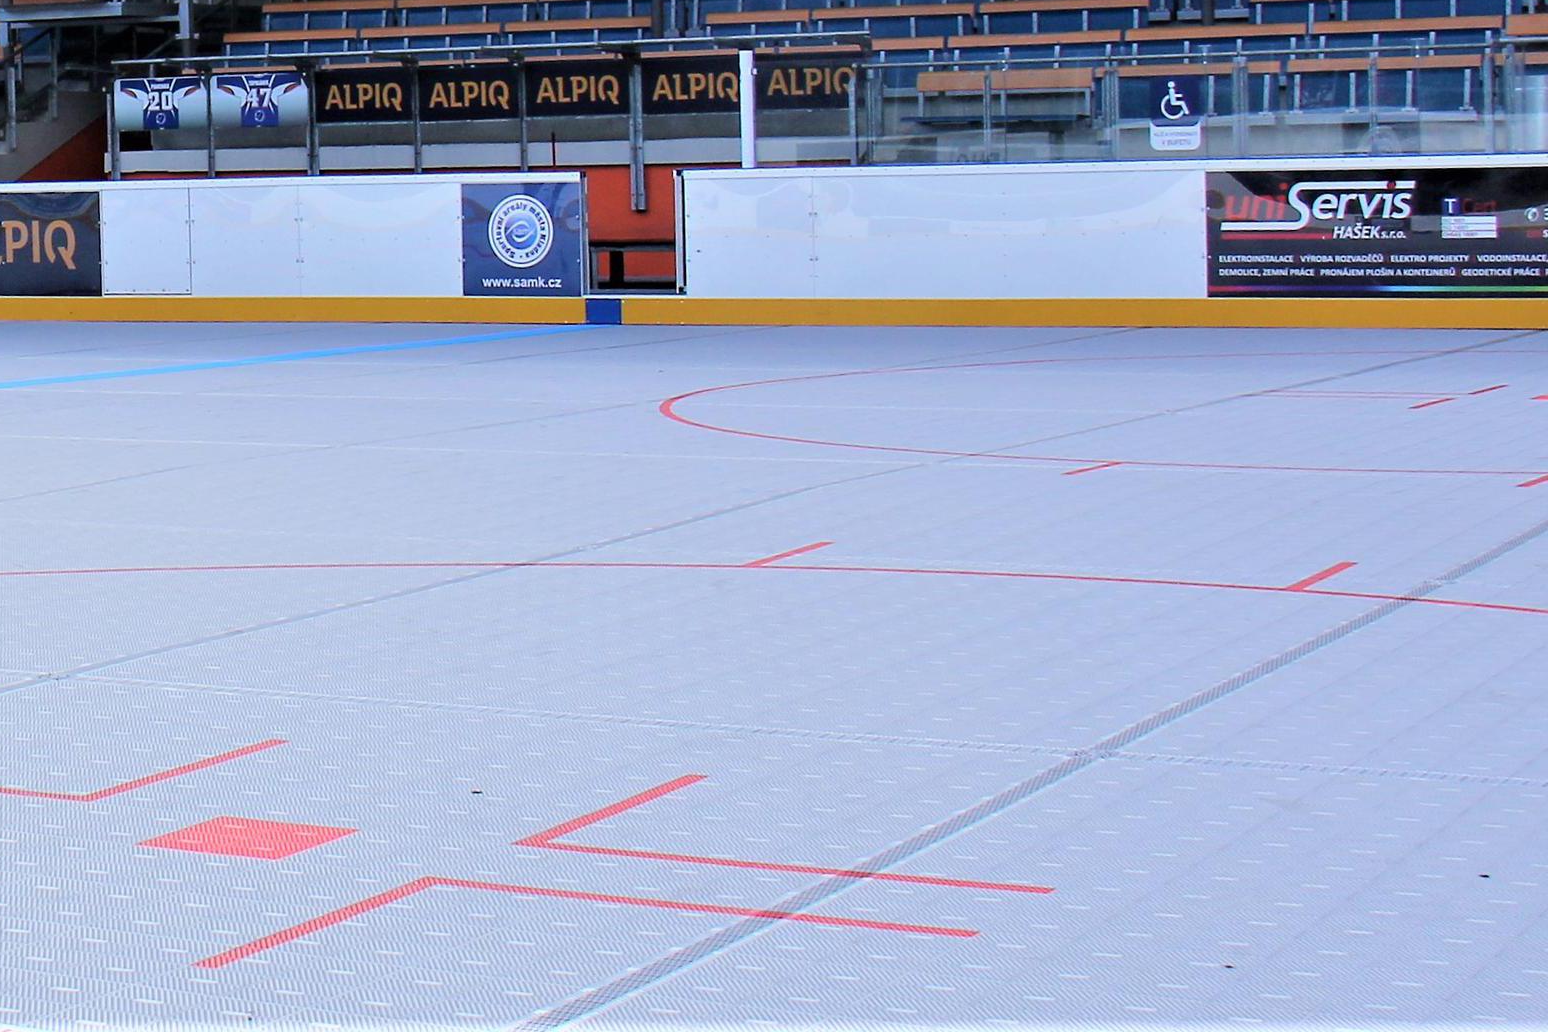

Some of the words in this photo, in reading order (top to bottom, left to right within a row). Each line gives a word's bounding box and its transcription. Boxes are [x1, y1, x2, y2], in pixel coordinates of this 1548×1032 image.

[536, 74, 620, 105] ALPIQ
[653, 71, 739, 102] ALPIQ
[767, 66, 856, 97] ALPIQ
[148, 91, 173, 110] 20
[246, 88, 272, 108] 47
[325, 82, 403, 112] ALPIQ
[429, 79, 510, 110] ALPIQ
[1332, 222, 1381, 239] HAŠEK
[1381, 230, 1407, 239] s.r.o.
[1219, 254, 1294, 263] ELEKTROINSTALACE
[1300, 253, 1333, 263] VÝROBA
[1390, 254, 1427, 263] ELEKTRO
[1428, 254, 1469, 263] PROJEKTY
[482, 276, 562, 288] www.samk.cz
[1219, 268, 1261, 277] DEMOLICE,
[1290, 267, 1314, 276] PRÁCE
[1320, 267, 1364, 277] PRONÁJEM
[1366, 267, 1393, 276] PLOŠIN
[1461, 267, 1512, 276] GEODETICKÉ
[1514, 267, 1540, 276] PRÁCE
